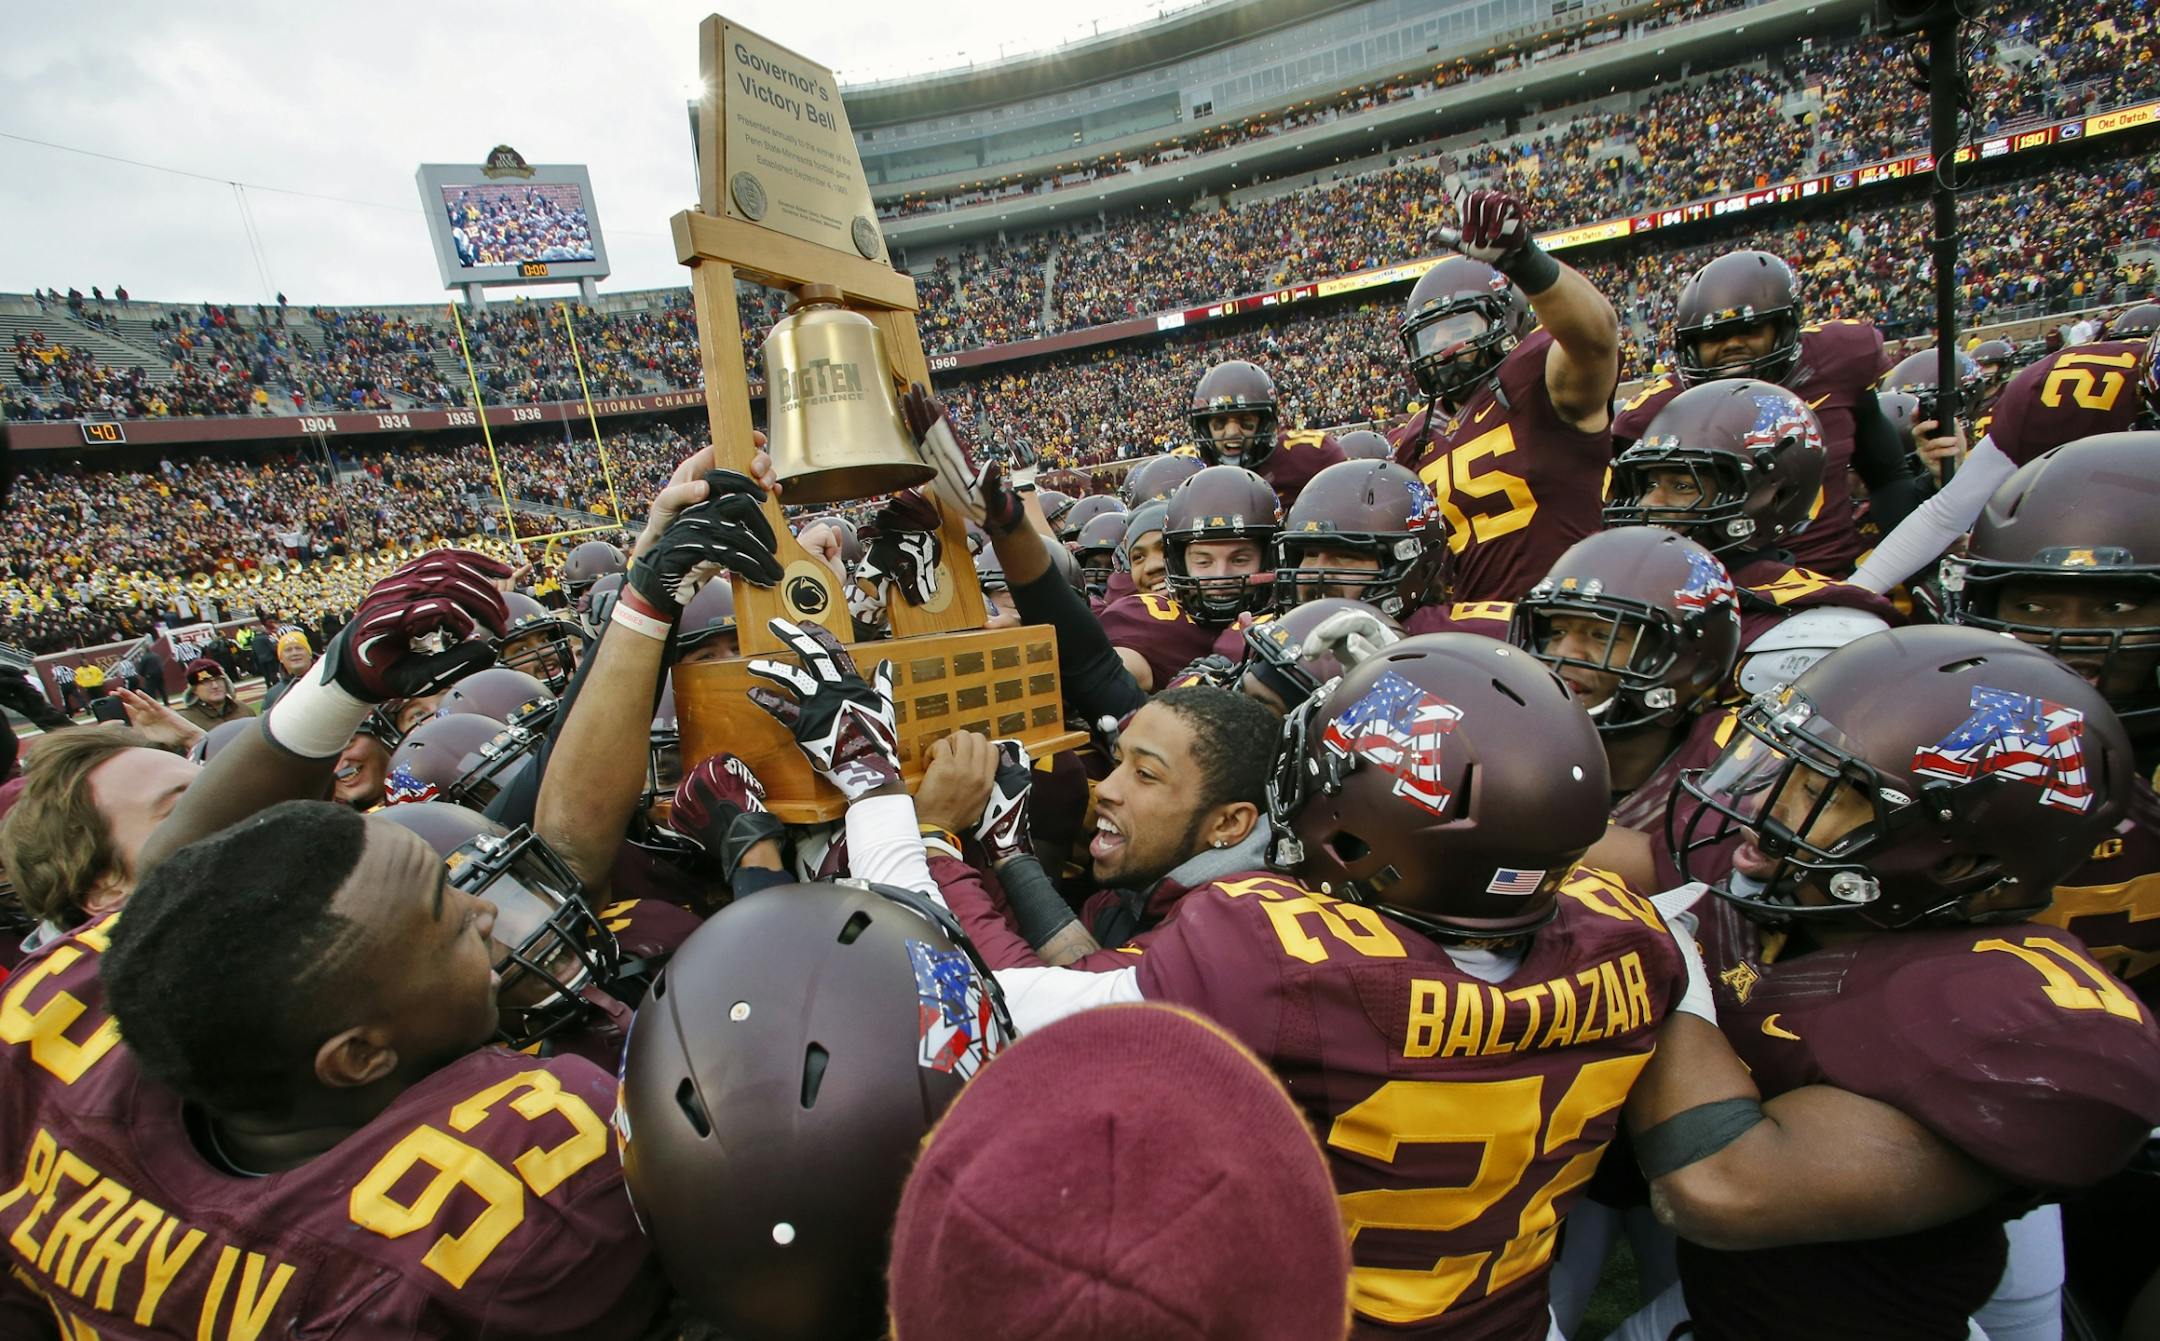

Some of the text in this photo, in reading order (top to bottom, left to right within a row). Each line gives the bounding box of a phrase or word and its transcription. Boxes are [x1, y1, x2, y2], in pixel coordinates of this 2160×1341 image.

[1494, 4, 1608, 43] UNIVERSITY
[734, 43, 829, 102] Governor's
[738, 72, 837, 133] Victory Bell
[2098, 112, 2148, 130] Old Dutch
[2020, 132, 2046, 149] 190
[1803, 181, 1818, 196] 10
[524, 264, 548, 277] 0:00
[930, 356, 957, 370] 1960
[780, 392, 865, 413] CONFERENCE
[376, 415, 411, 429] 1934
[446, 412, 476, 425] 1935
[512, 408, 542, 422] 1936
[90, 424, 117, 441] 40
[298, 417, 337, 433] 1904
[1880, 789, 1910, 804] SPEED
[1972, 936, 2144, 1024] 11
[1403, 951, 1653, 1058] BALTAZAR
[350, 1068, 608, 1290] 93
[1327, 1043, 1656, 1323] 22
[0, 1128, 297, 1341] PERRY IV
